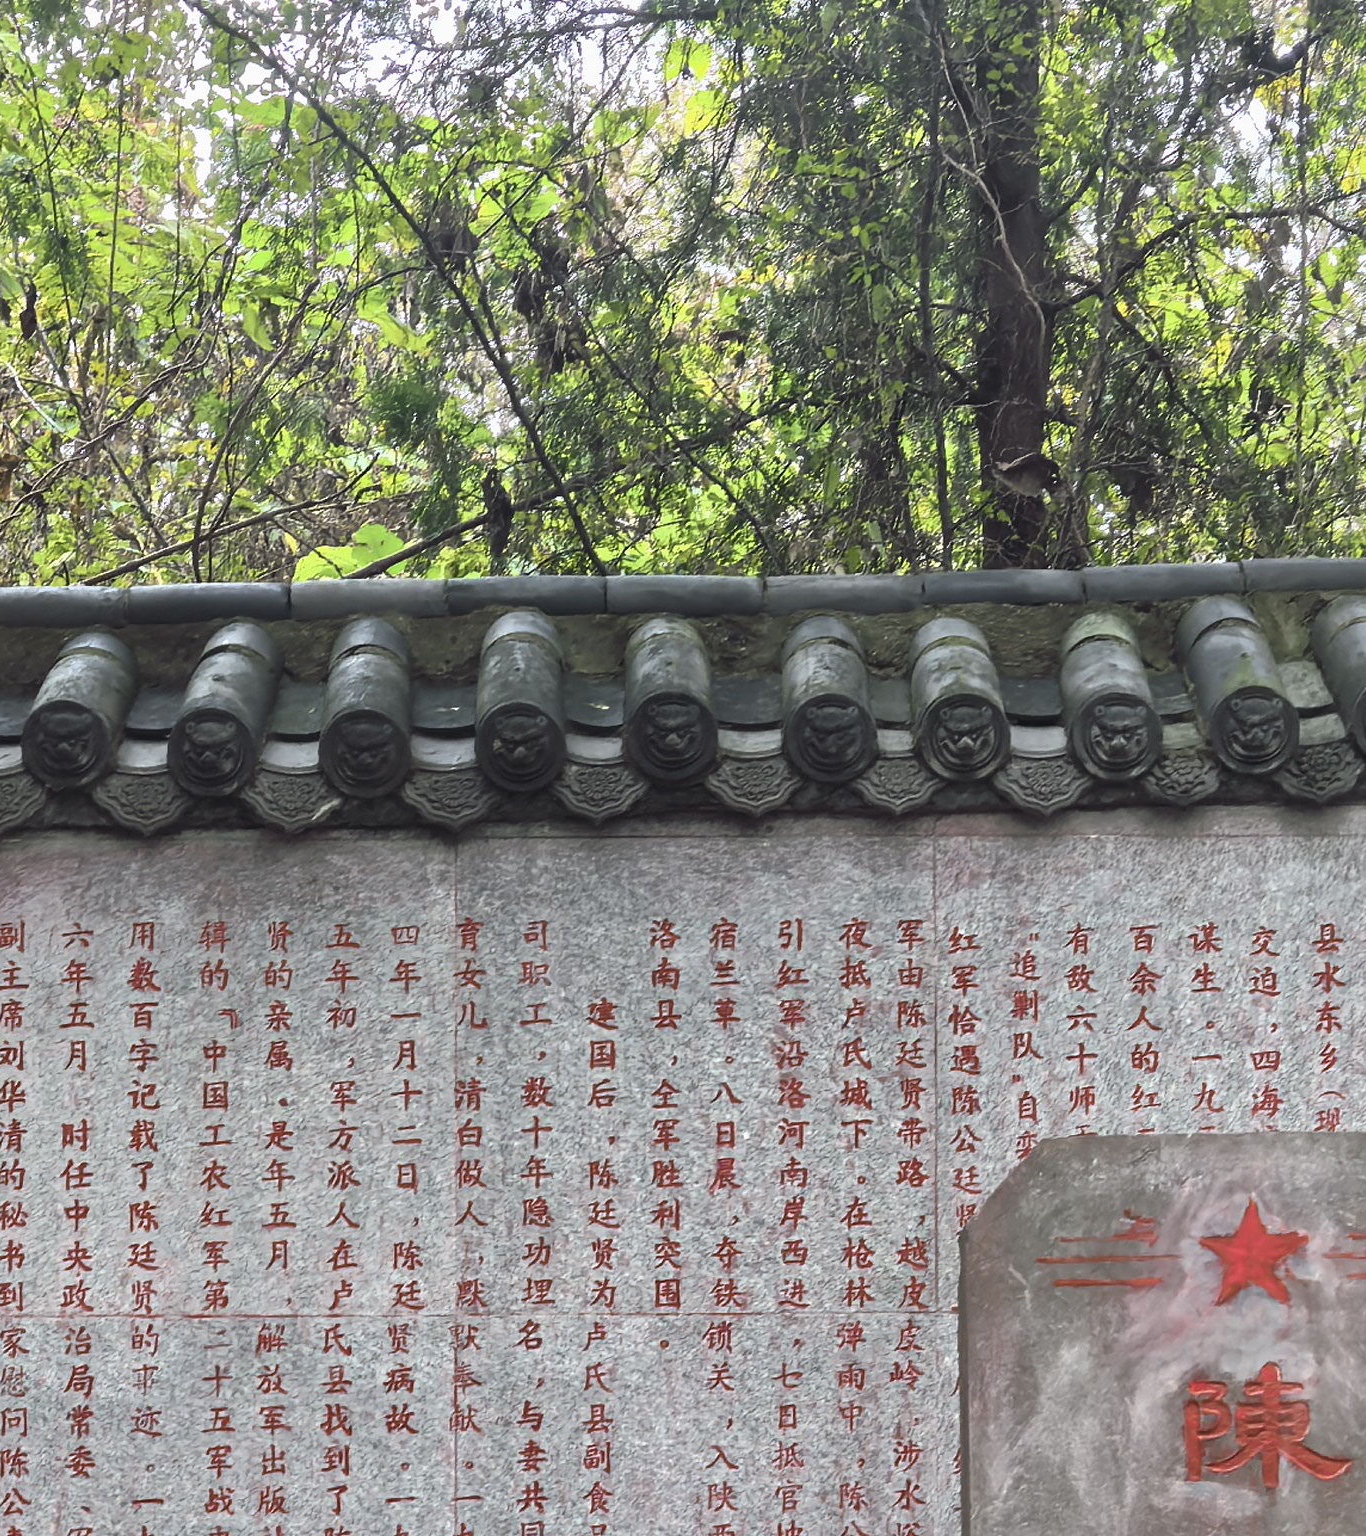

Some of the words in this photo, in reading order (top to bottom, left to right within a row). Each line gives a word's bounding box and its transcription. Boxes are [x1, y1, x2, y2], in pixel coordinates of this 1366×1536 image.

[1126, 922, 1163, 1135] 百余人的红
[1187, 921, 1225, 1132] 谋生。一九
[1247, 925, 1285, 1132] 交迫，四海
[649, 918, 683, 1350] 洛南县，全军胜利突围。
